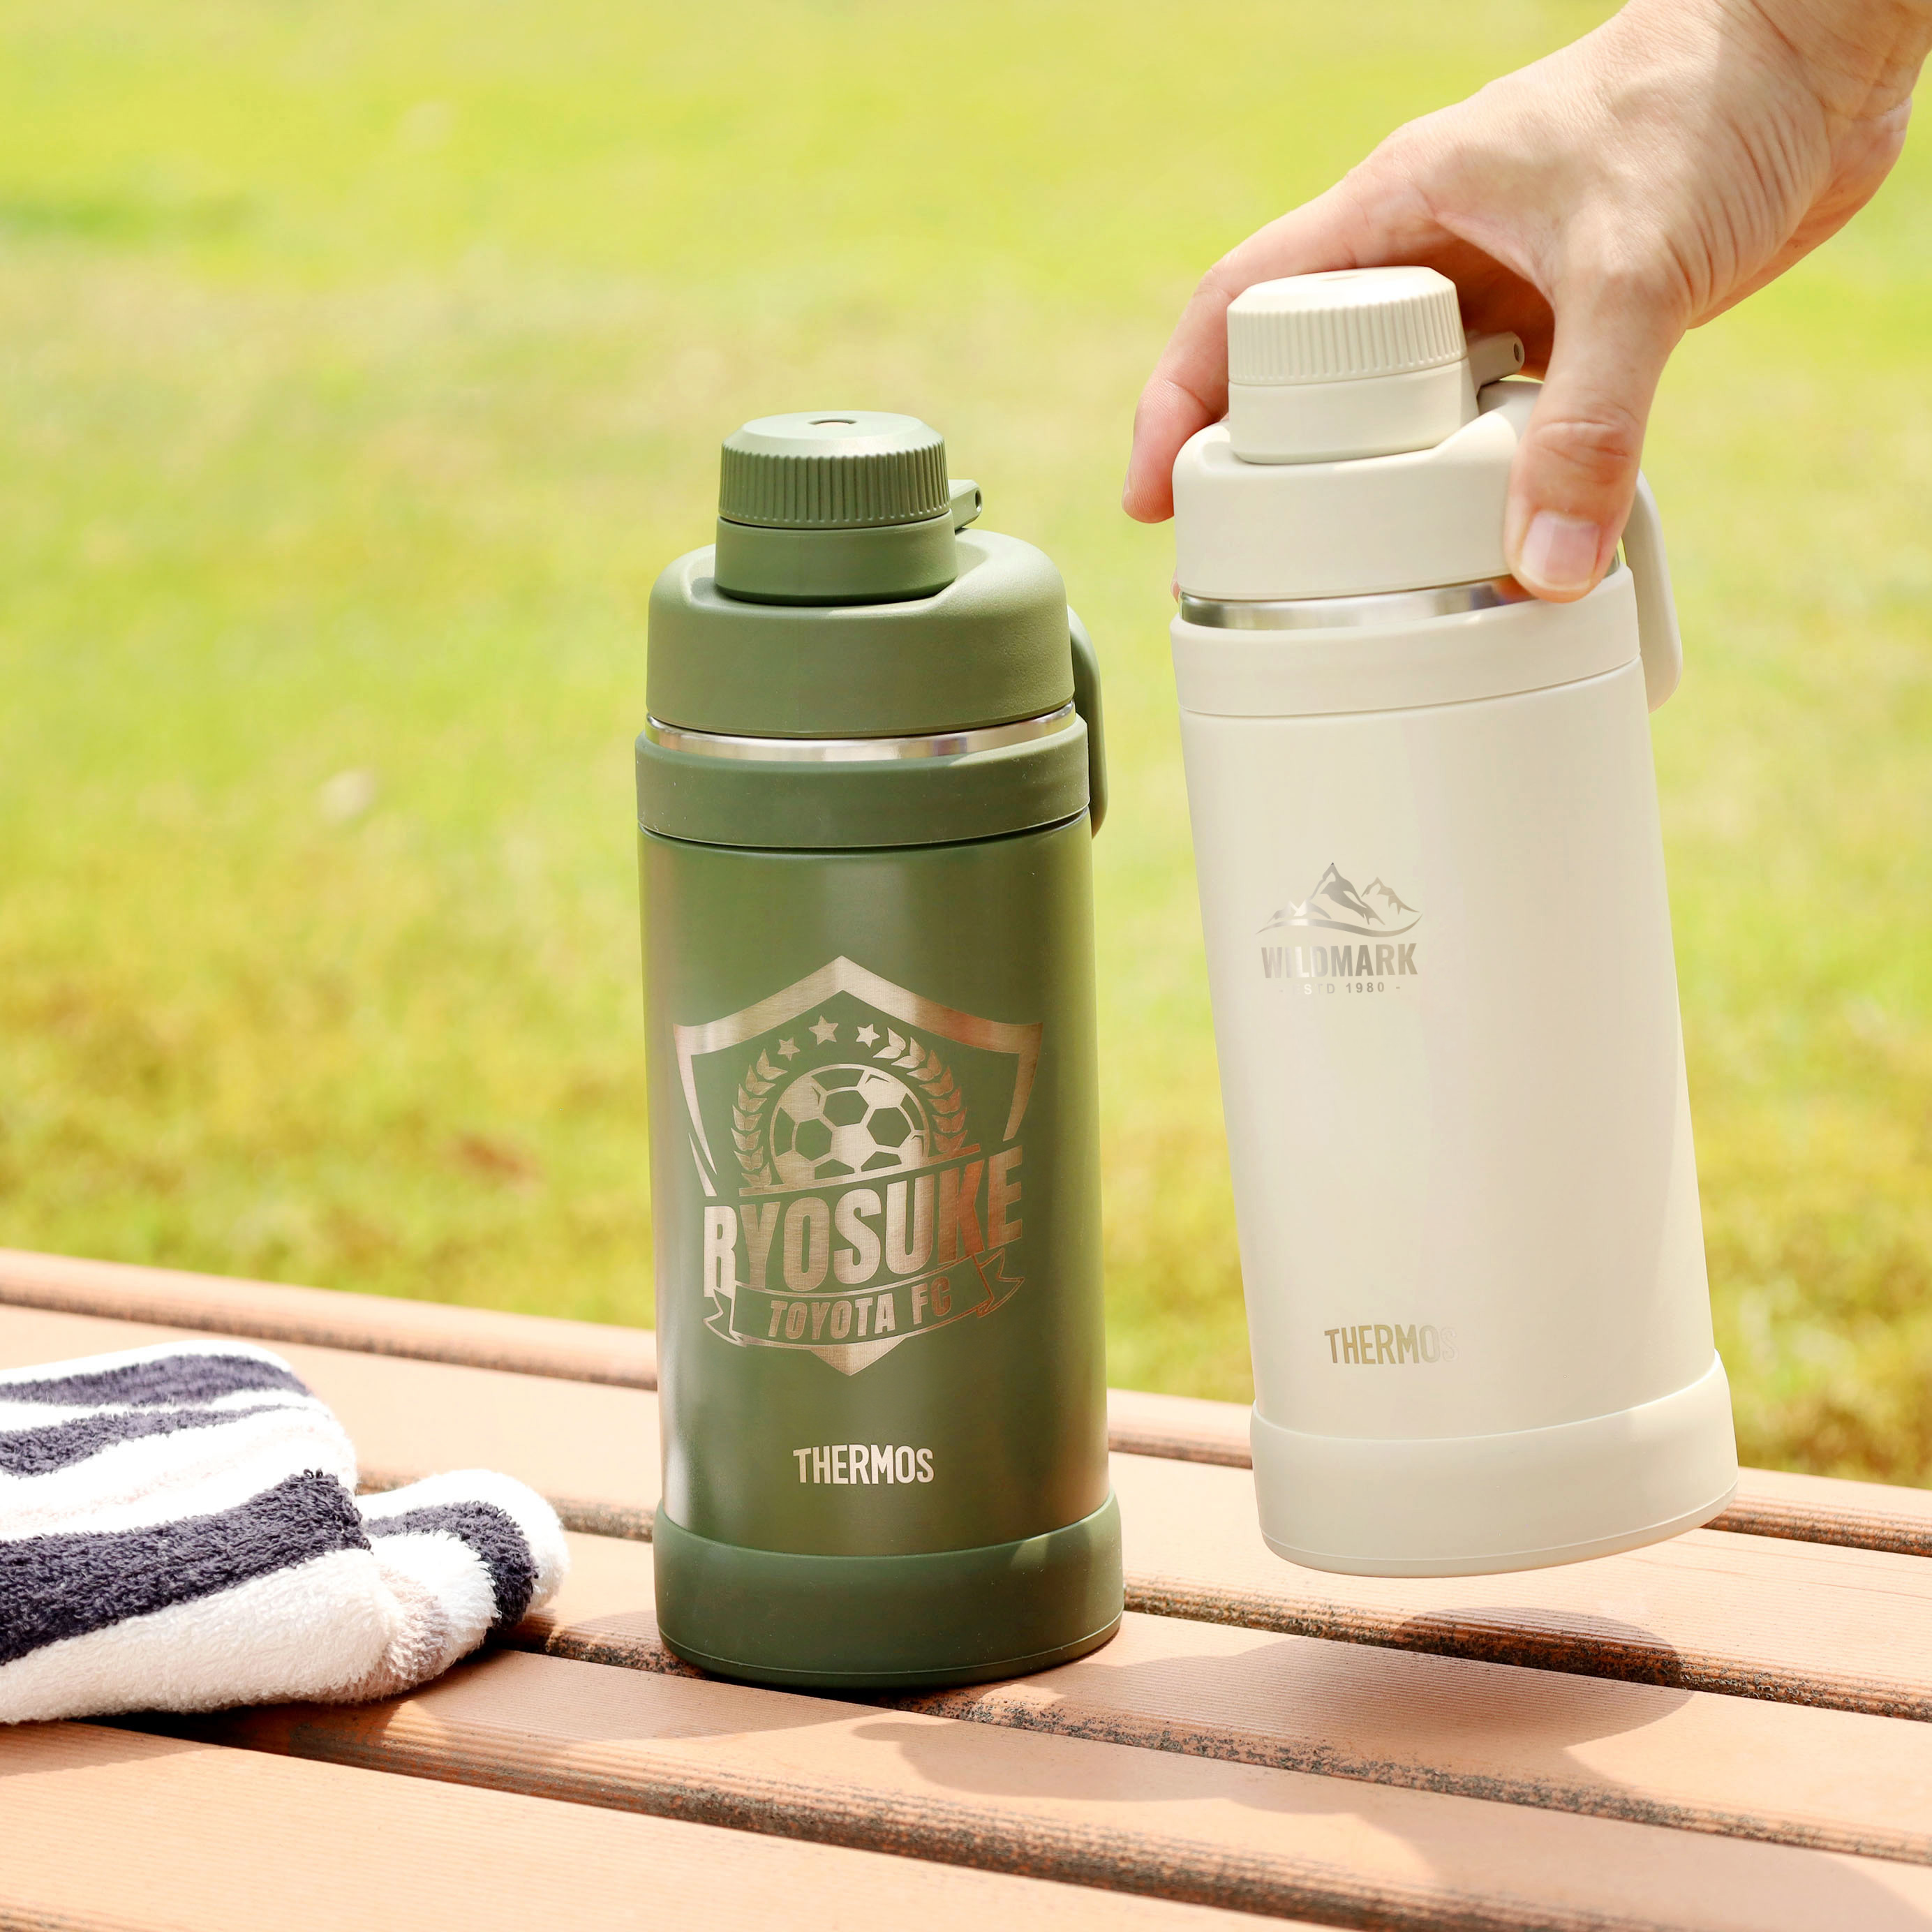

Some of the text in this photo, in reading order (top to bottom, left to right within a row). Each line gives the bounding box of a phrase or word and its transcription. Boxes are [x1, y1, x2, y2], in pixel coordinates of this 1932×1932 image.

[1261, 943, 1418, 979] WILDMARK
[1345, 981, 1385, 994] 1980
[704, 1145, 1023, 1297] RYOSUKE
[768, 1277, 952, 1340] TOYOTA FC
[793, 1444, 935, 1484] THERMOS
